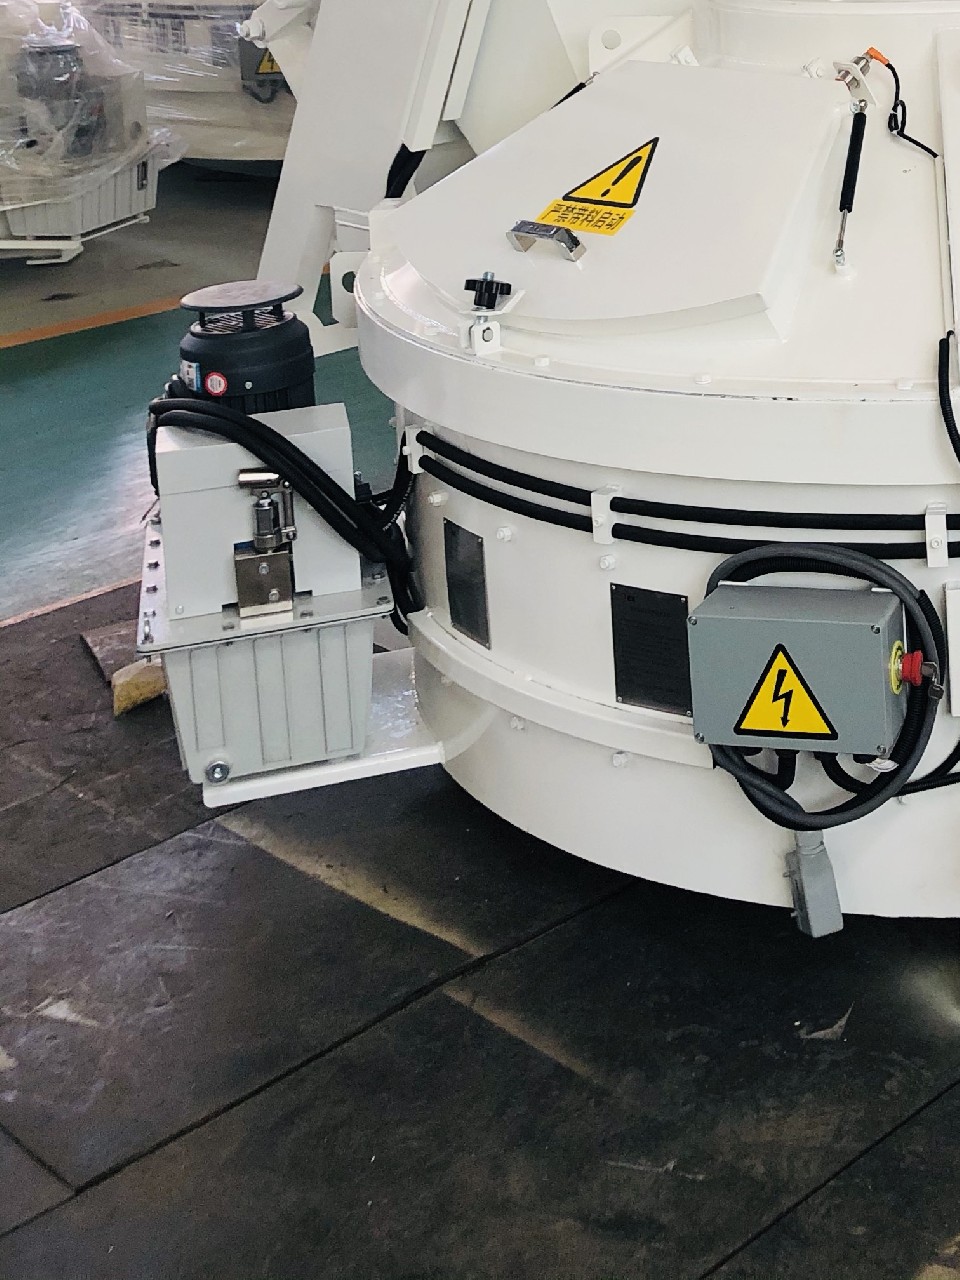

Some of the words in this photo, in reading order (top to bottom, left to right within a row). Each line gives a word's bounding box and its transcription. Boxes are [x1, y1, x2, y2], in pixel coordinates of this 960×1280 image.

[541, 203, 626, 230] 严禁带料启动
